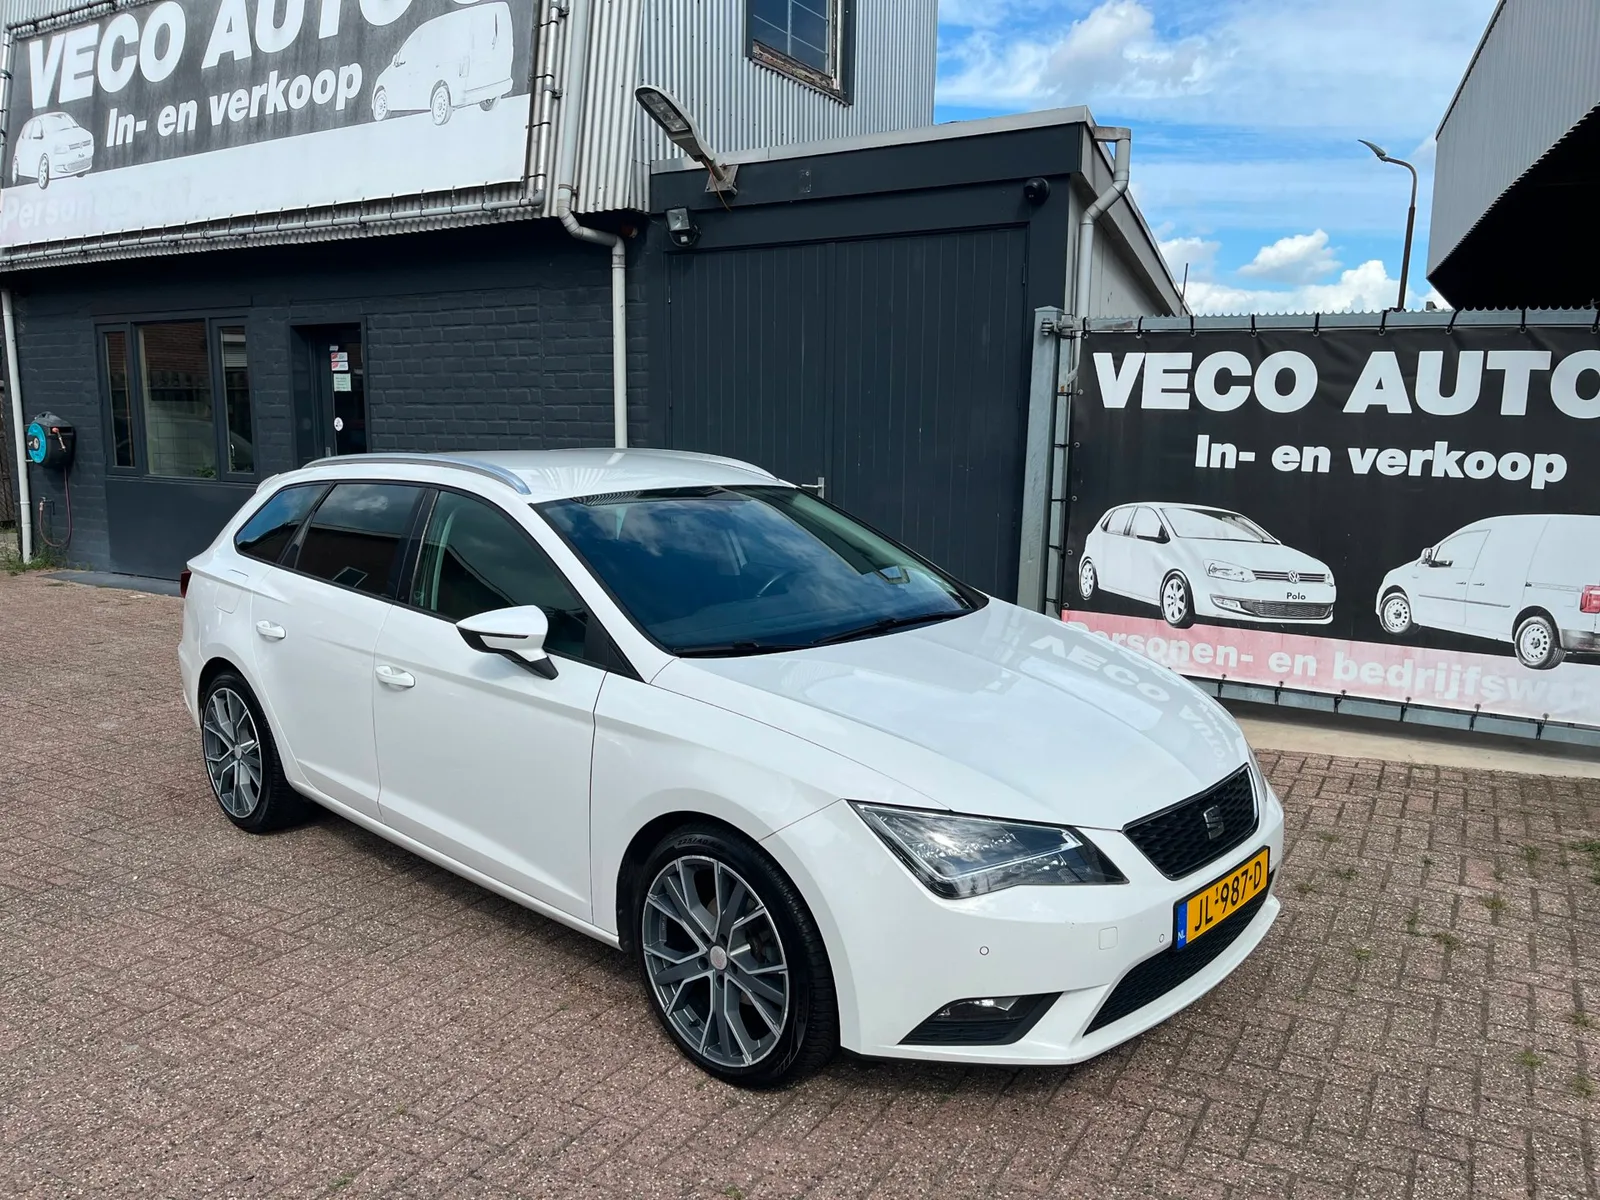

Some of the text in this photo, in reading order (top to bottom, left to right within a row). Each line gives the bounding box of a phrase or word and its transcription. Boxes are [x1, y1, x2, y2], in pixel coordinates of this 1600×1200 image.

[28, 0, 187, 110] VECO
[106, 62, 363, 148] In- en verkoop
[1092, 350, 1319, 413] VECO
[1195, 435, 1568, 489] In- en verkoop
[1286, 592, 1306, 601] Polo
[1268, 646, 1317, 678] en
[1177, 929, 1186, 941] NL
